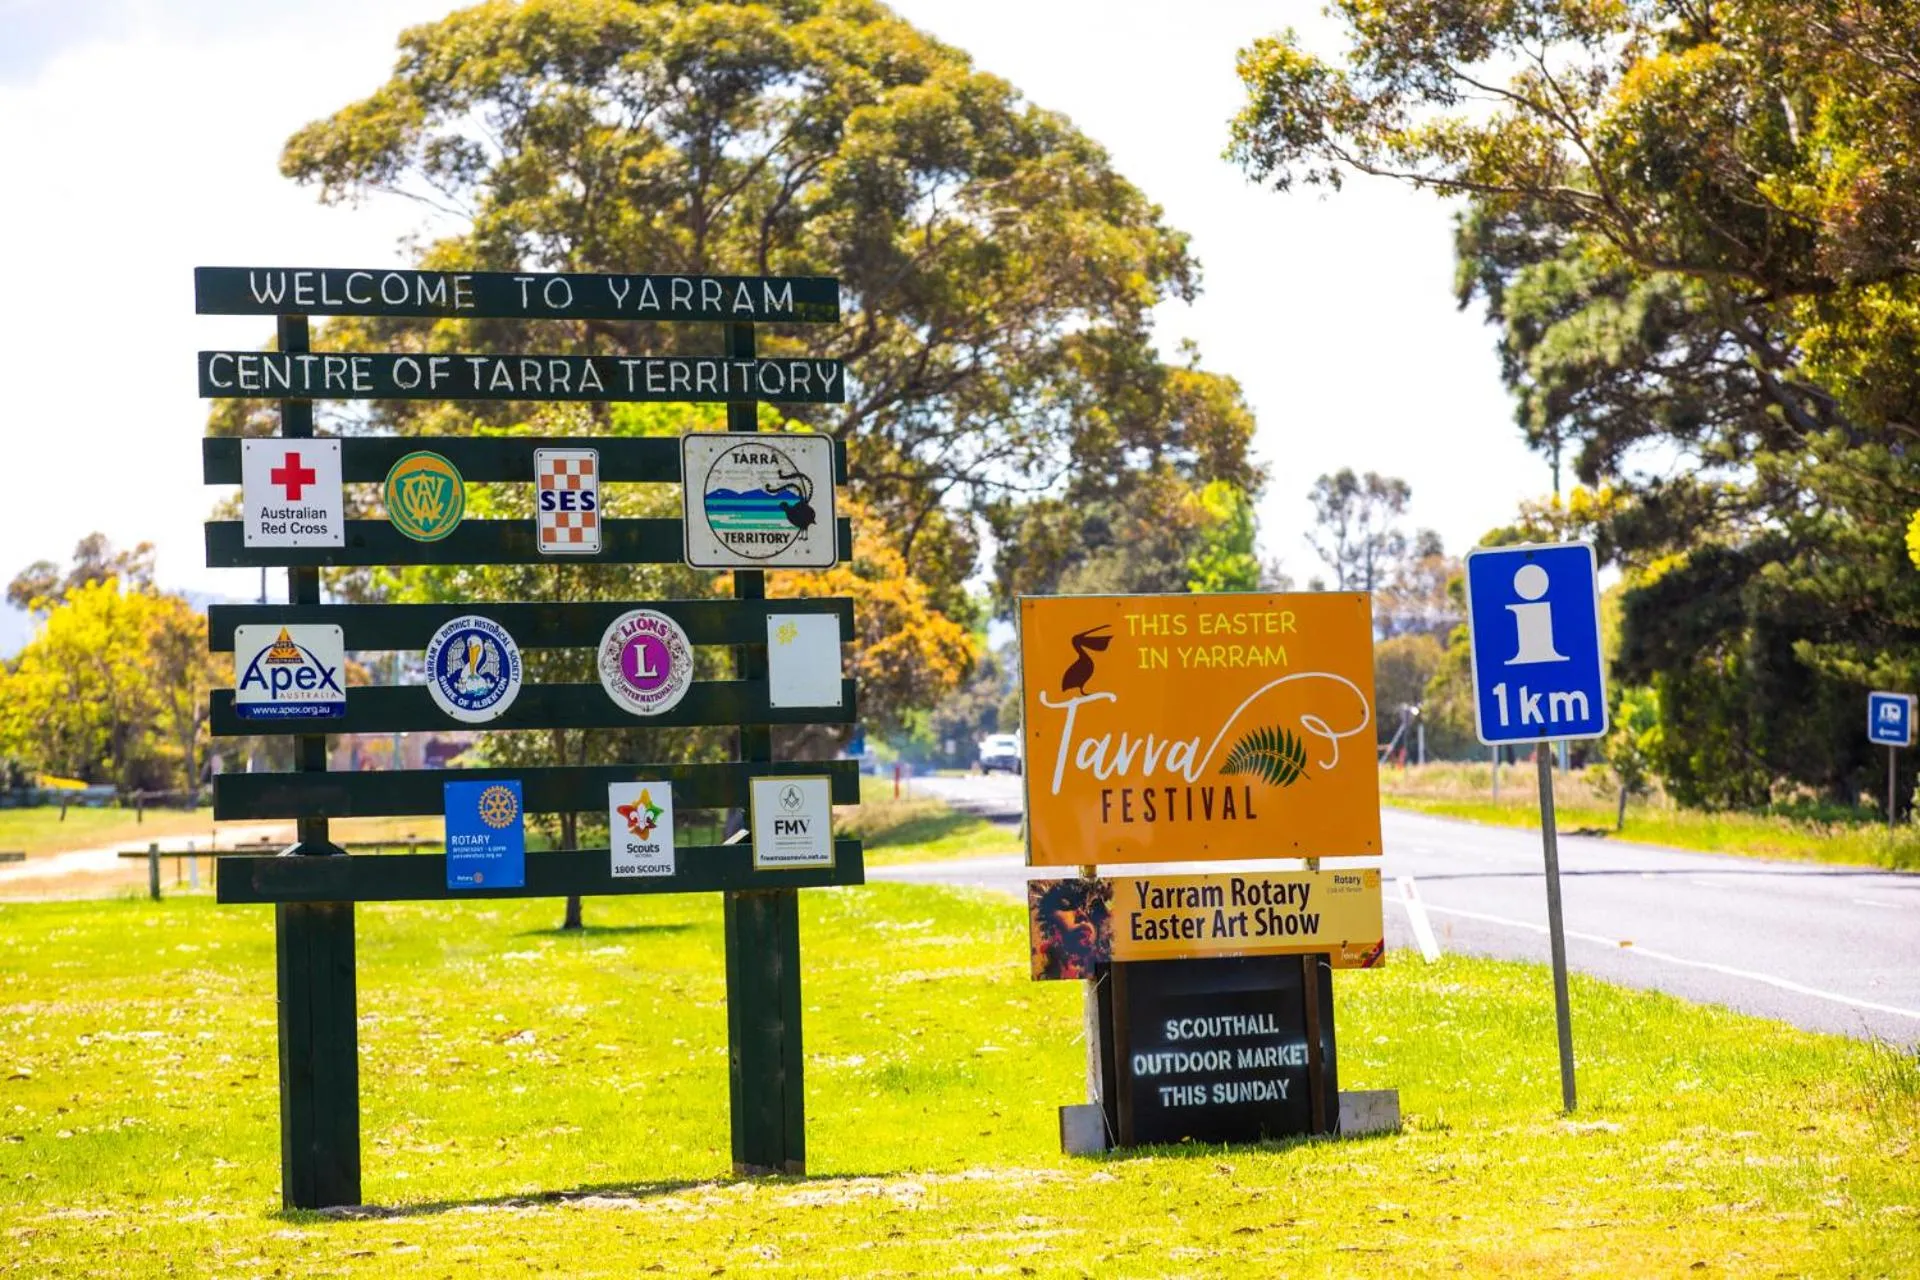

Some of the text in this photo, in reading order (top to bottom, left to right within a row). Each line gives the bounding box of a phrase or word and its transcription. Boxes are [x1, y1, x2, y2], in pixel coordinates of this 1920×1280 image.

[250, 271, 794, 313] WELCOME TO YARRAM
[208, 353, 837, 394] CENTRE OF TARRA TERRITORY
[732, 453, 779, 465] TARRA
[260, 506, 327, 520] Australian
[540, 490, 596, 512] SES
[261, 521, 328, 535] Red Cross
[723, 532, 790, 544] TERRITORY
[620, 618, 668, 638] LIONS
[1124, 611, 1297, 636] THIS EASTER
[427, 647, 438, 683] YARRAM
[441, 619, 471, 637] DISTRICT
[474, 619, 511, 647] HISTORICAL
[510, 649, 520, 683] SOCIETY
[634, 644, 658, 677] L
[1138, 644, 1288, 669] IN YARRAM
[240, 645, 344, 700] Apex
[439, 675, 508, 709] SHIRE OF ALBERTON
[620, 683, 674, 702] INTERNATIONAL
[1492, 682, 1590, 726] 1 km
[252, 705, 330, 716] www.apex.org.au
[1101, 785, 1258, 824] FESTIVAL
[774, 819, 811, 835] FMV
[451, 835, 490, 846] ROTARY
[626, 843, 660, 854] Scouts
[615, 864, 672, 874] 1800 SCOUTS
[1334, 875, 1361, 886] Rotary
[1135, 877, 1311, 912] Yarram Rotary
[1130, 907, 1320, 941] Easter Art Show
[1166, 1013, 1279, 1041] SCOUTHALL
[1133, 1043, 1309, 1076] OUTDOOR MARKET
[1158, 1078, 1290, 1107] THIS SUNDAY
